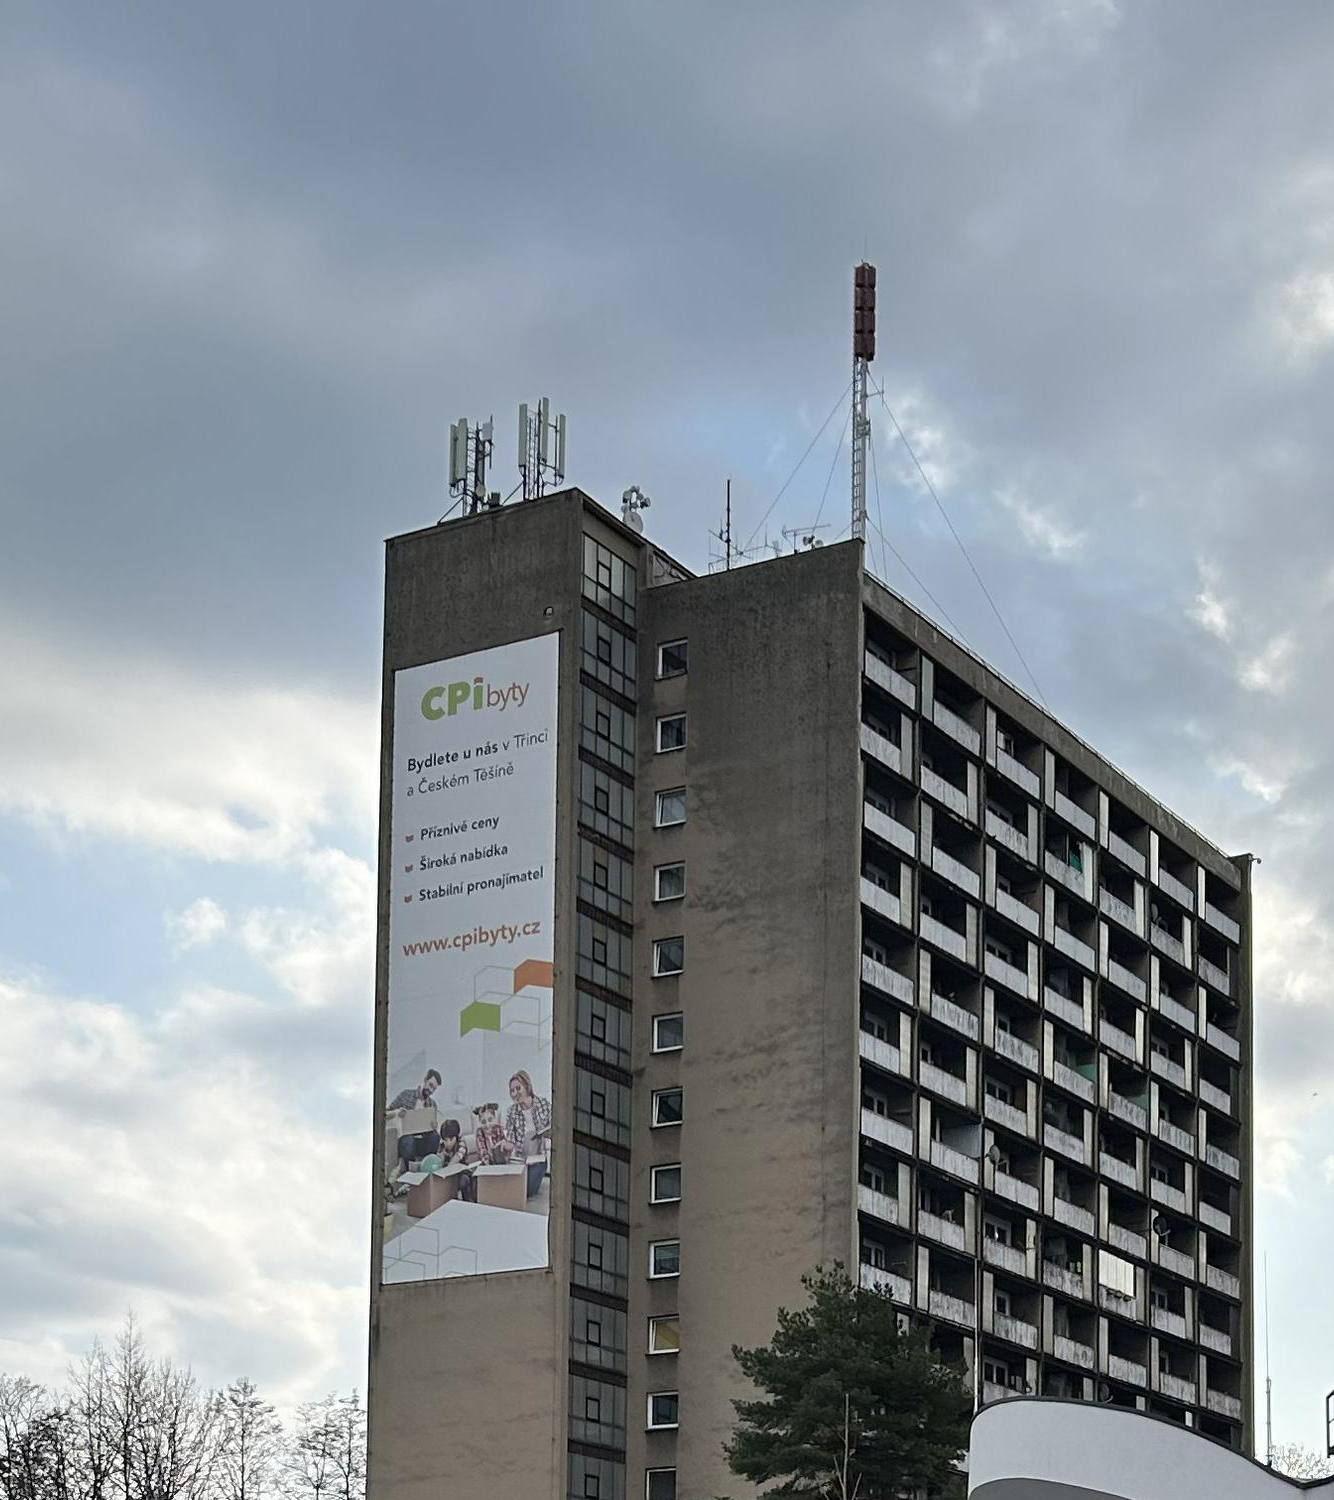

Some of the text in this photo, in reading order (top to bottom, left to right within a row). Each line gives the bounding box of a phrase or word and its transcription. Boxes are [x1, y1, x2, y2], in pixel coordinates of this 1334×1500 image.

[407, 728, 548, 774] Bydlete u nás v Třinci
[407, 761, 514, 797] a Českém Těšíně
[420, 816, 500, 841] Příznivé ceny
[419, 843, 508, 871] Široká nabídka
[419, 865, 544, 902] Stabilní pronajímatel
[402, 921, 541, 957] www.cpibyty.cz
